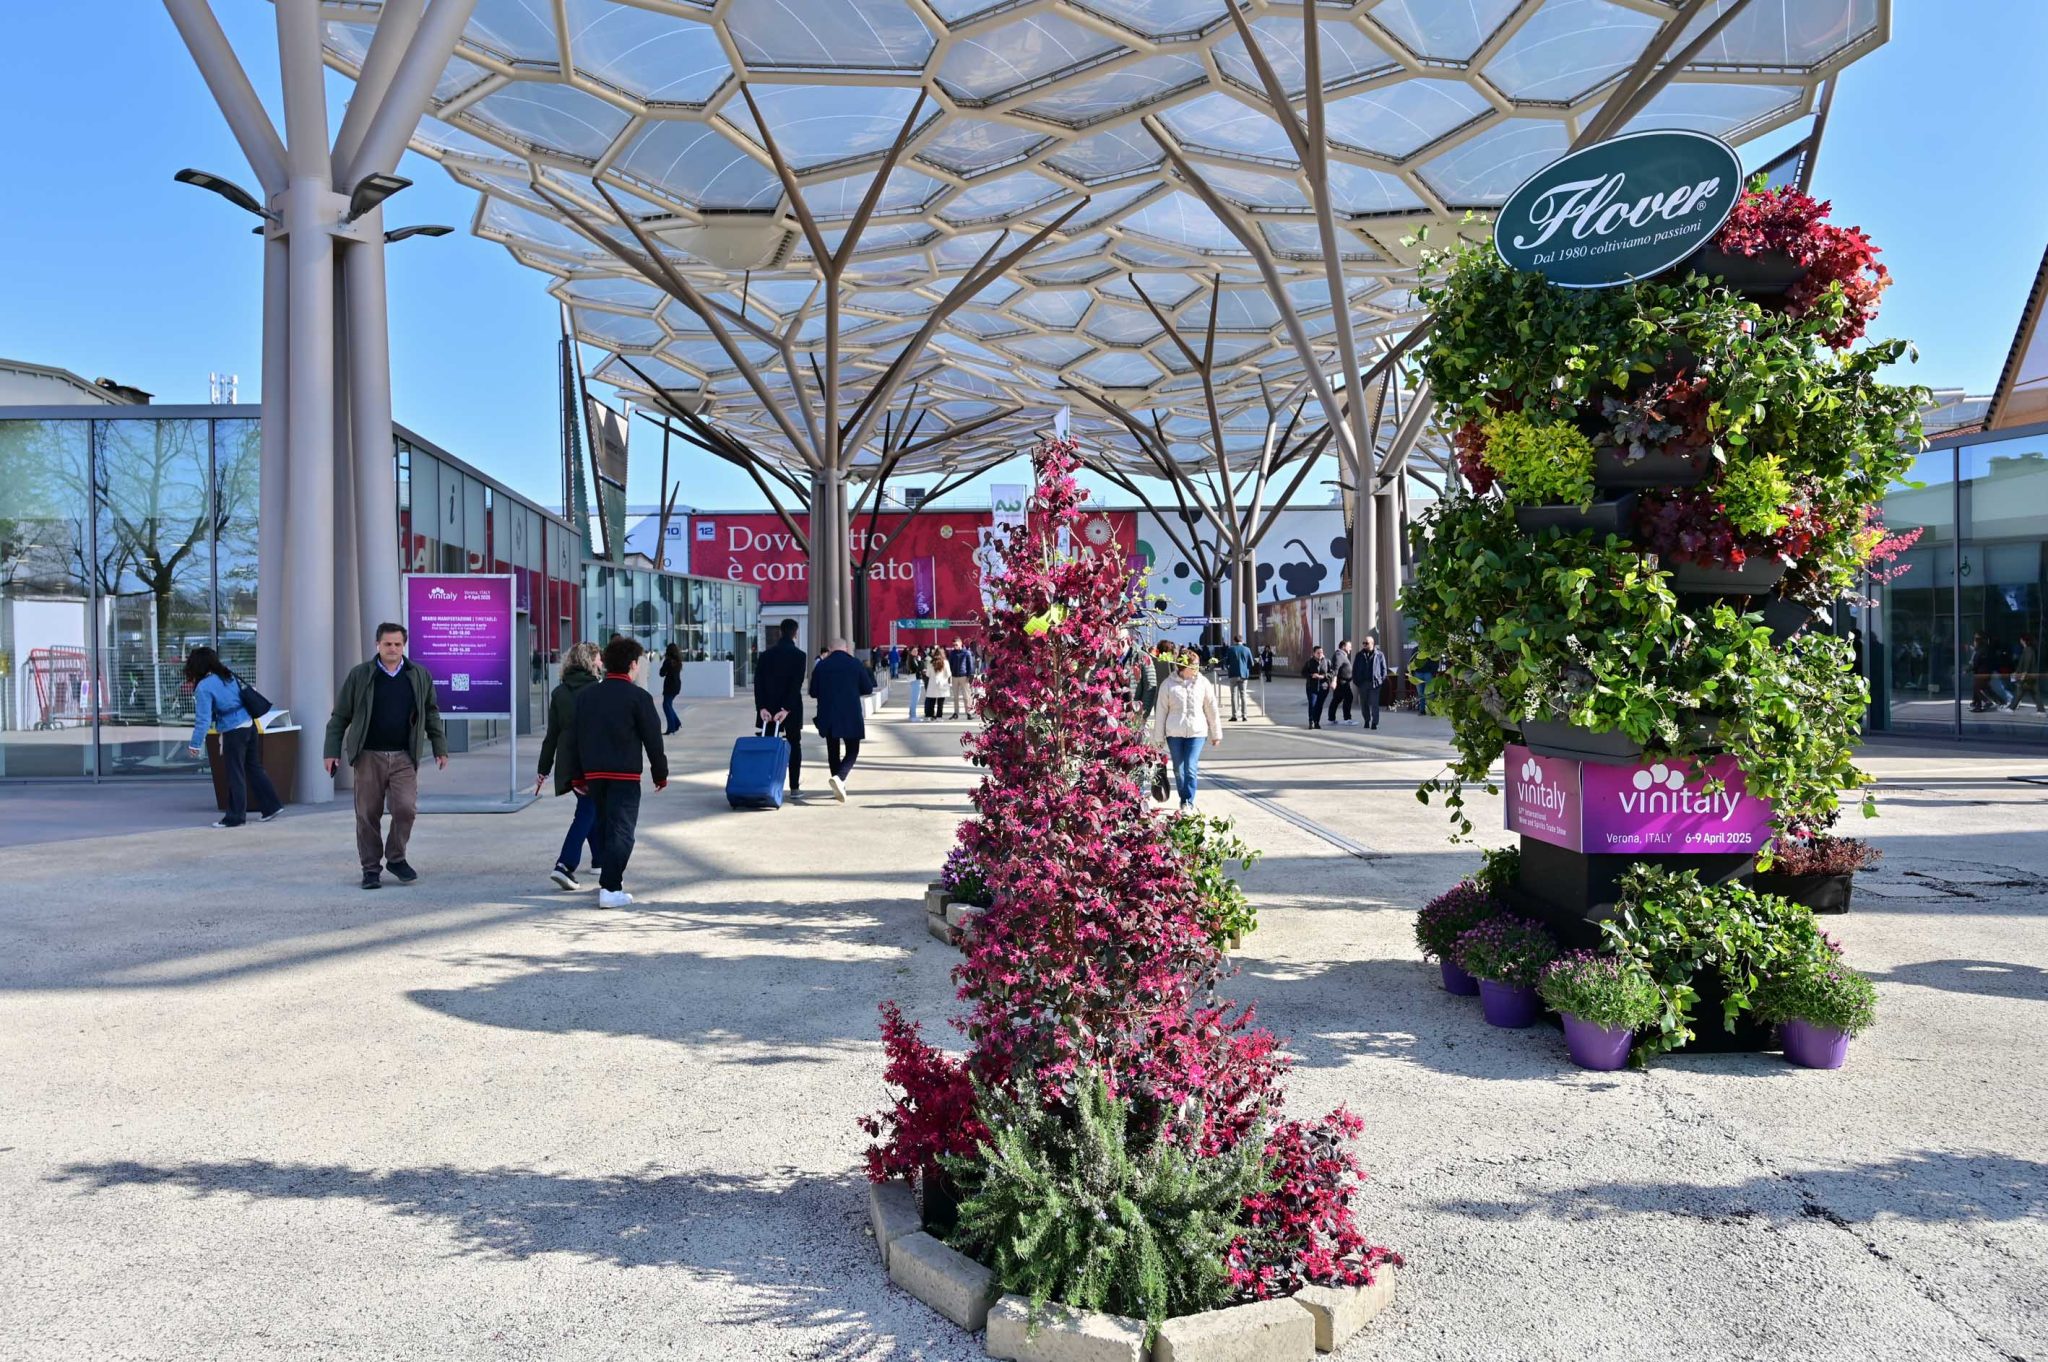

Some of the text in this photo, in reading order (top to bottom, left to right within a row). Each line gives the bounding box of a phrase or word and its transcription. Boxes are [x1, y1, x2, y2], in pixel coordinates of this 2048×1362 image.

[1513, 172, 1720, 249] Flover
[1533, 219, 1702, 265] Dal 1980 coltiviamo passioni
[665, 527, 679, 535] 10
[699, 527, 714, 535] 12
[727, 556, 743, 581] è
[1517, 781, 1566, 818] vinitaly
[1618, 787, 1741, 822] vinitaly
[1606, 832, 1752, 846] Verona, ITALY 6-9 April 2025
